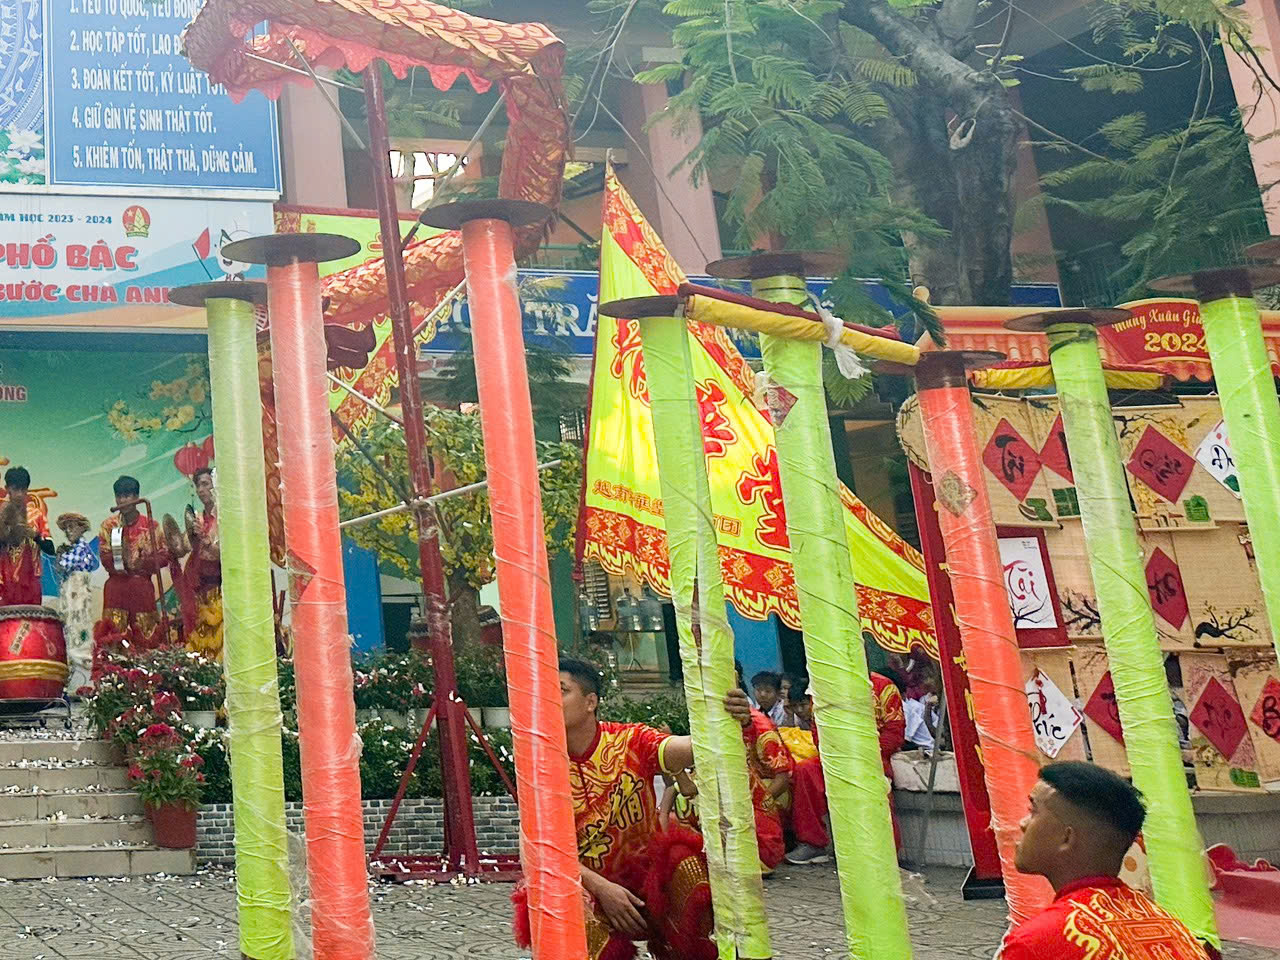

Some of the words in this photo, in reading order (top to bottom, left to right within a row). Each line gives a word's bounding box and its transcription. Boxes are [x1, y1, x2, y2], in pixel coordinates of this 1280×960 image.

[70, 30, 80, 51] 2.
[82, 30, 103, 56] HỌC
[105, 25, 125, 56] TẬP
[127, 24, 150, 58] TỐT,
[152, 33, 171, 55] LAO
[71, 67, 80, 90] 3.
[83, 64, 111, 90] ĐOÀN
[113, 61, 133, 91] KẾT
[136, 63, 159, 96] TỐT,
[161, 64, 175, 94] KỶ
[177, 67, 203, 99] LUẬT
[72, 106, 82, 129] 4.
[84, 102, 101, 130] GIỮ
[104, 104, 120, 130] GÌN
[123, 103, 137, 134] VỆ
[140, 111, 163, 132] SINH
[165, 105, 191, 136] THẬT
[194, 104, 217, 134] TỐT.
[73, 145, 83, 168] 5.
[85, 141, 119, 169] KHIÊM
[121, 139, 145, 174] TỐN,
[147, 143, 174, 175] THẬT
[176, 144, 200, 176] THÀ,
[202, 145, 230, 173] DŨNG
[231, 143, 257, 174] CẢM.
[48, 214, 74, 224] 2023
[85, 215, 112, 225] 2024
[66, 285, 117, 303] CHA
